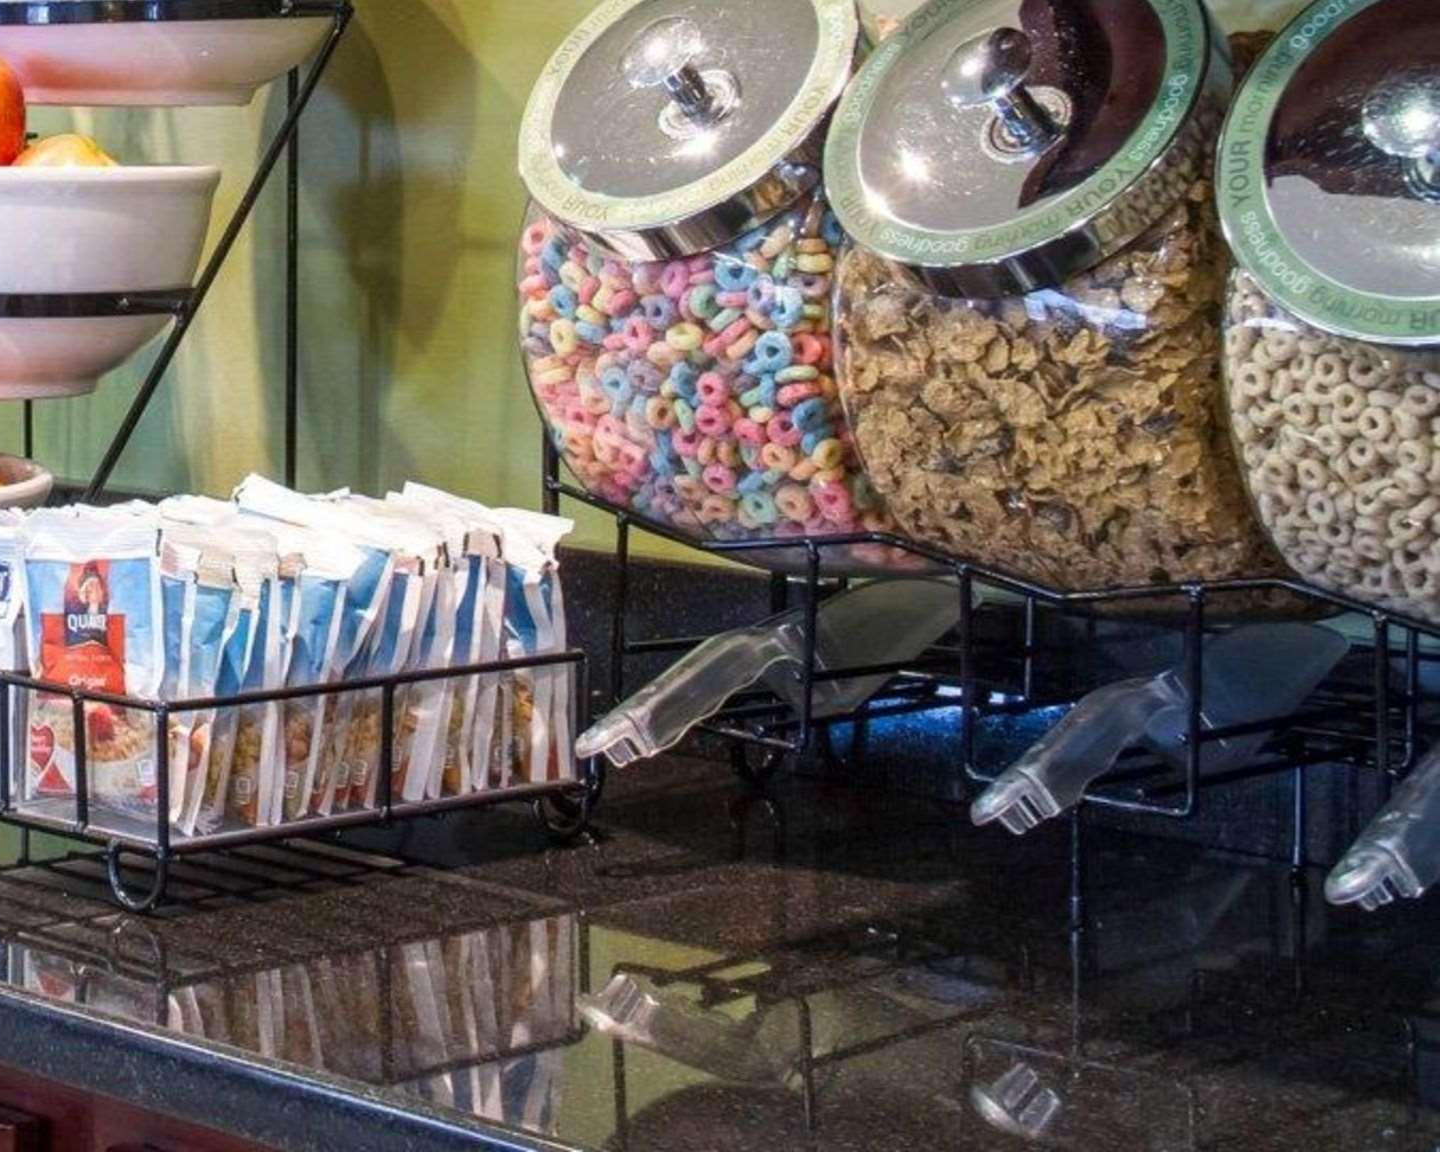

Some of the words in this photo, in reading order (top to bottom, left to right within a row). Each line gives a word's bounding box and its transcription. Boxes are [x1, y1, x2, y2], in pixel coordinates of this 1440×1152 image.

[1134, 72, 1190, 162] goodness
[1237, 45, 1291, 135] morning
[1066, 160, 1135, 213] YOUR
[1227, 134, 1253, 211] YOUR
[878, 227, 970, 254] goodness
[1239, 210, 1311, 296] goodness
